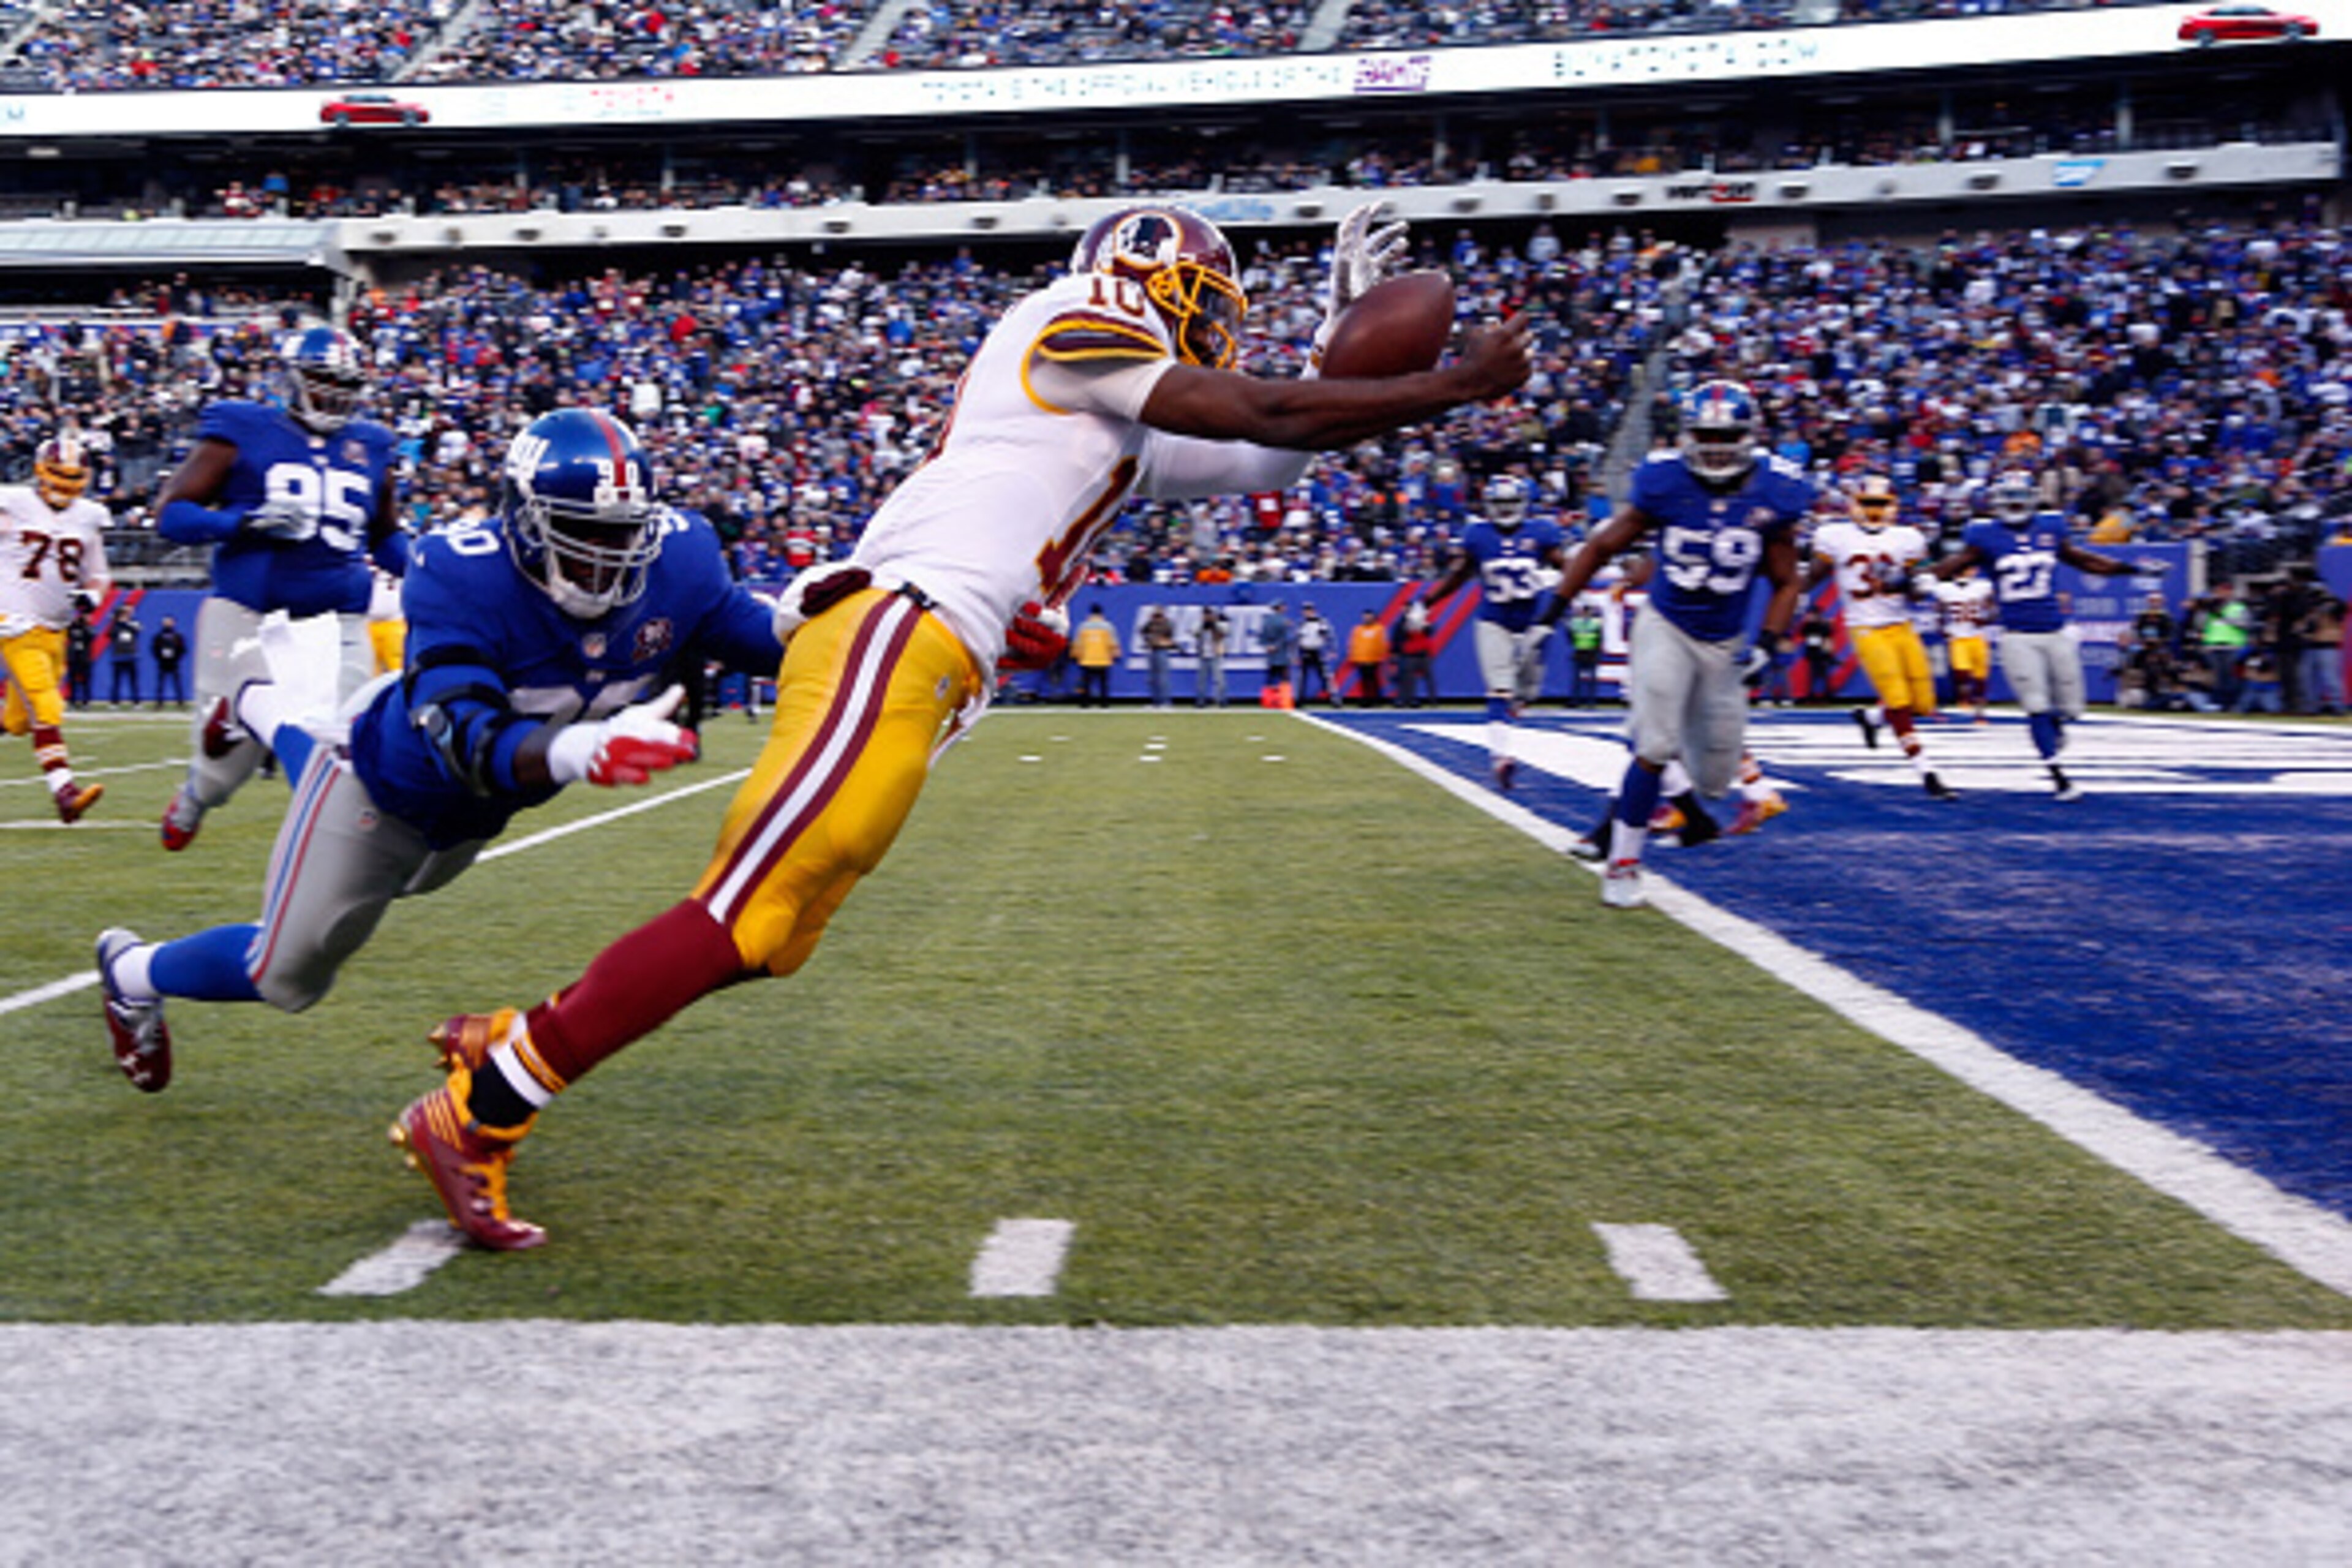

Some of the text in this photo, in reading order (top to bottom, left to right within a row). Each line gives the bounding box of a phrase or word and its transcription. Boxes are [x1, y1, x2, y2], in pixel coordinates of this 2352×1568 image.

[266, 462, 371, 550] 95
[20, 530, 84, 582] 78
[1481, 559, 1539, 603] 53
[1664, 527, 1762, 593] 59
[1995, 552, 2056, 601] 27
